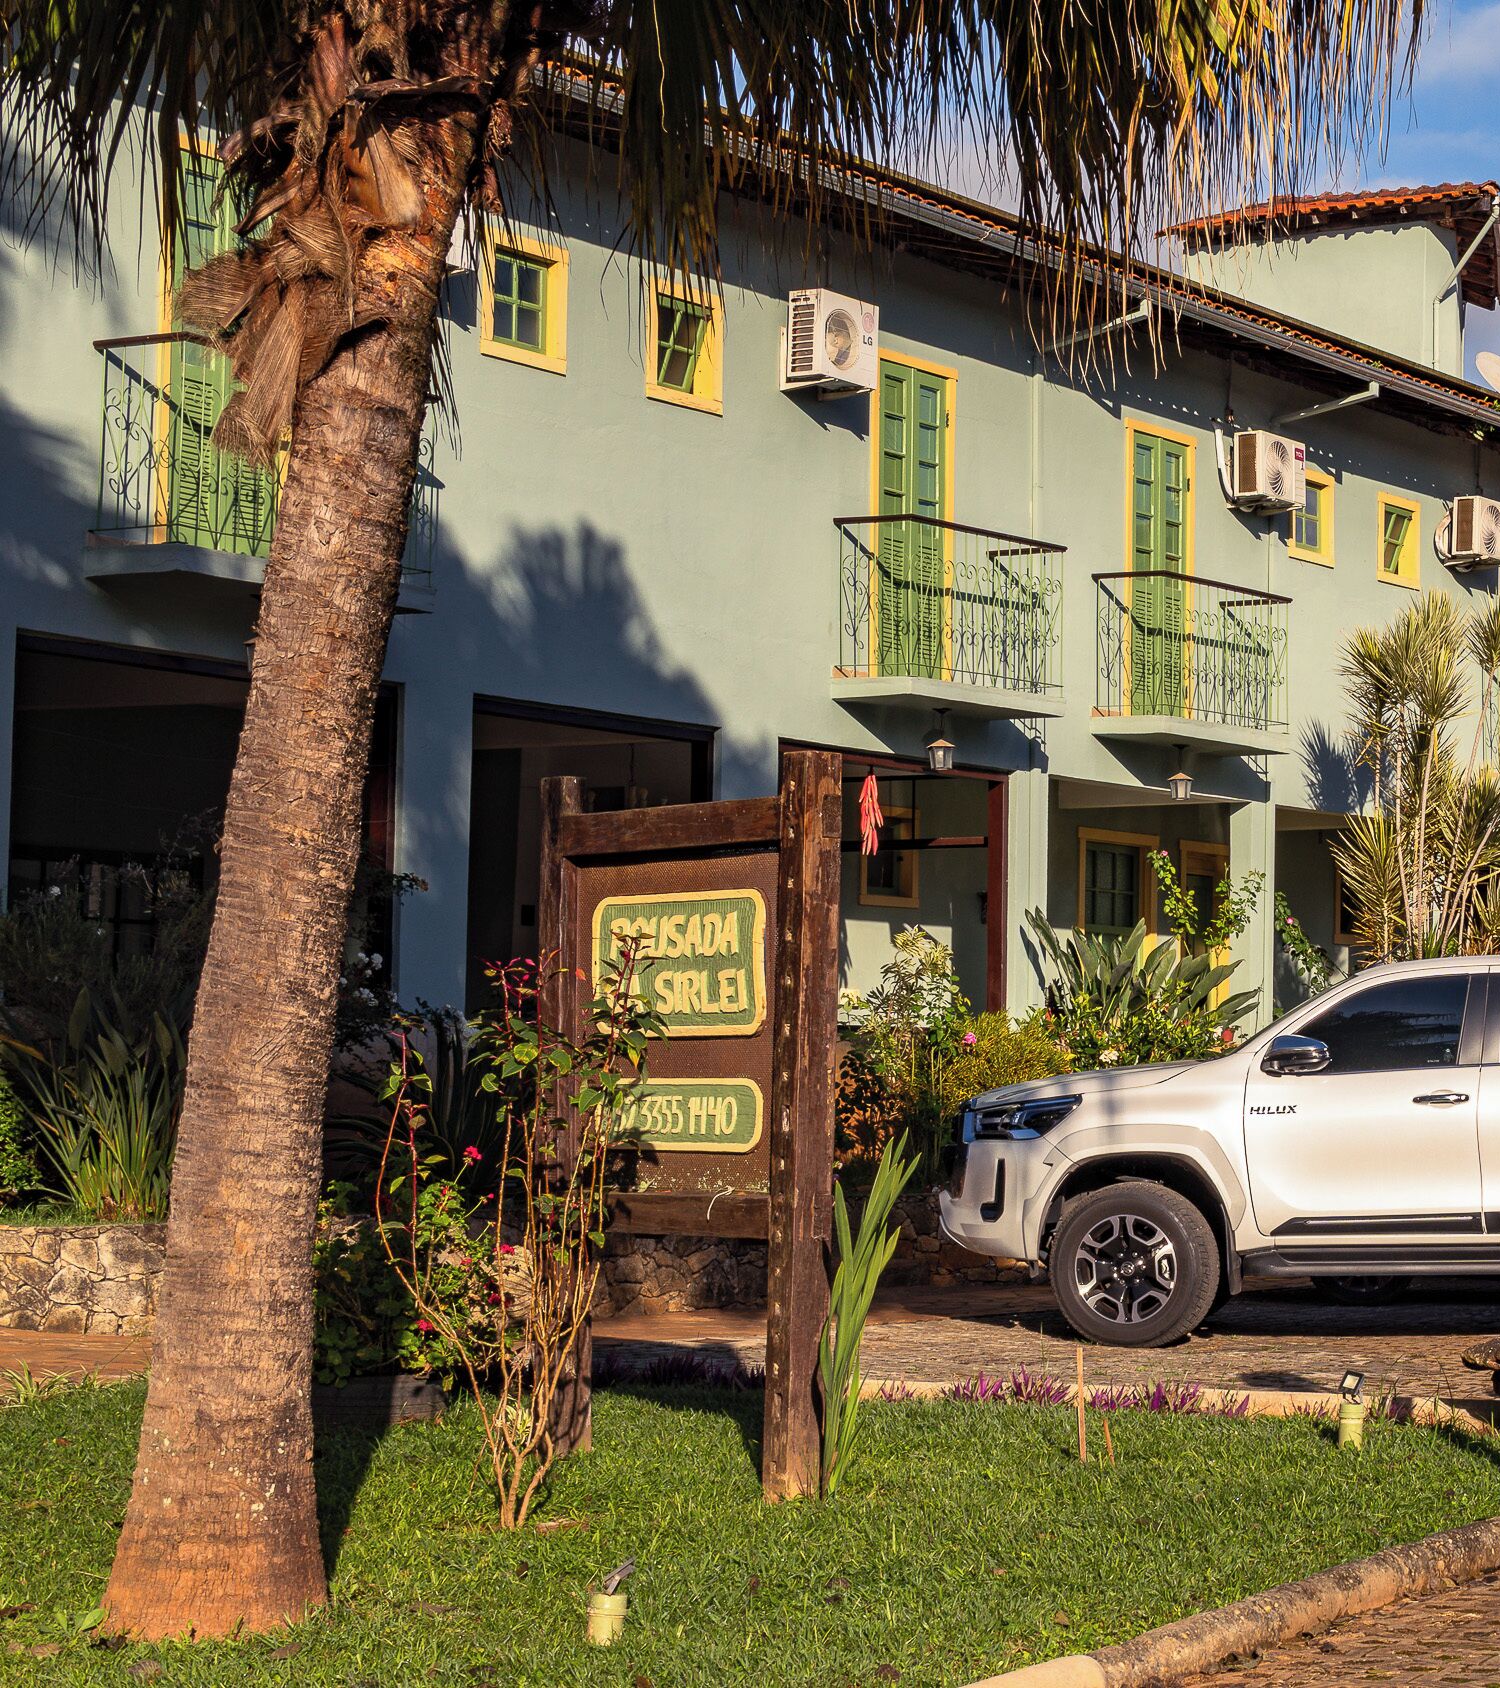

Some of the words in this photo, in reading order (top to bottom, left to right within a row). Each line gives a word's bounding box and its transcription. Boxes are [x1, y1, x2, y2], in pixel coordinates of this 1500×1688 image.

[862, 334, 873, 346] LG
[609, 911, 739, 961] POUSADA
[654, 967, 748, 1015] SIRLEI
[639, 1095, 684, 1134] 3355
[687, 1096, 738, 1136] 1440
[1250, 1105, 1298, 1115] HILUX
